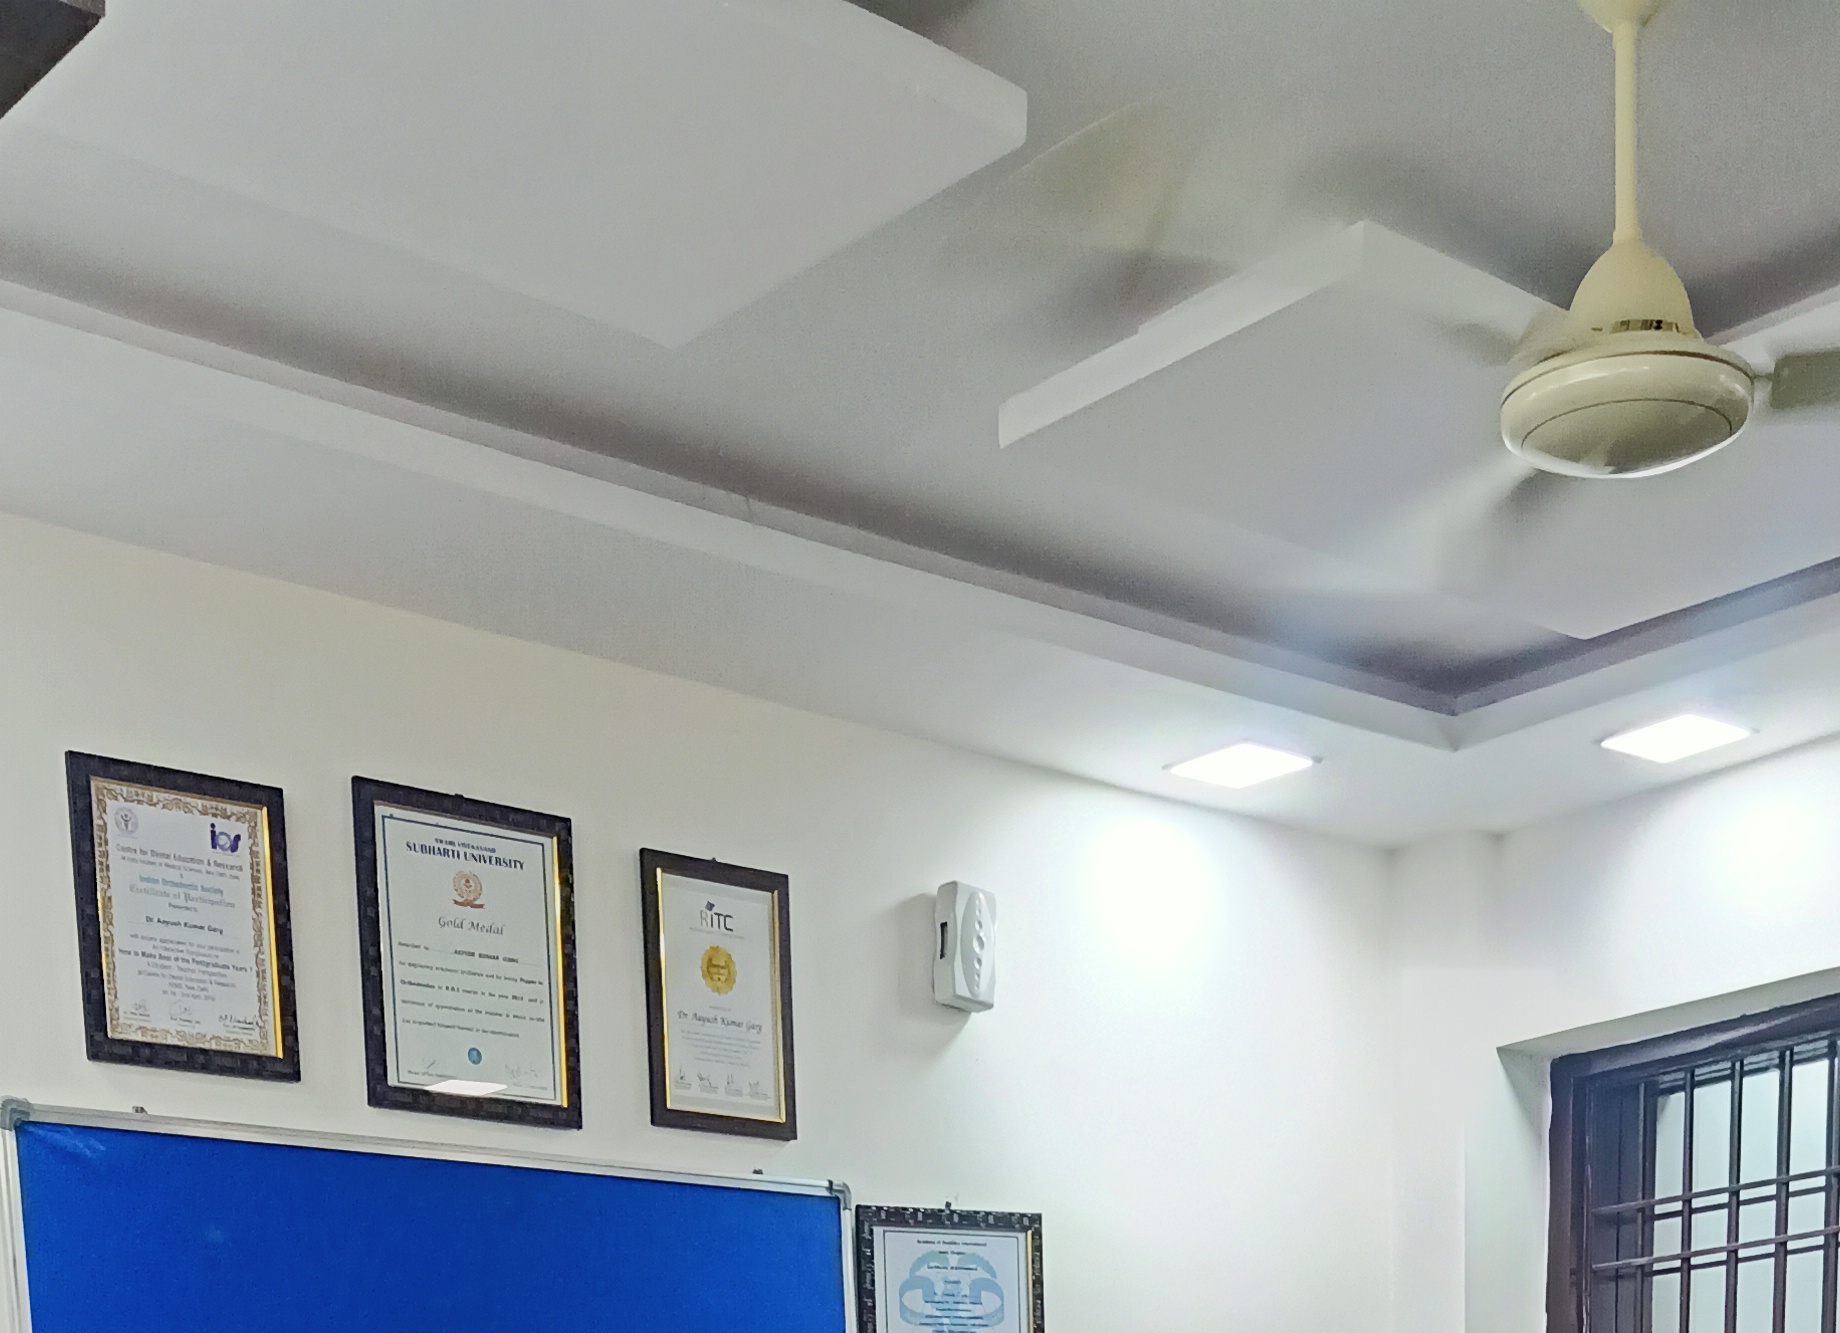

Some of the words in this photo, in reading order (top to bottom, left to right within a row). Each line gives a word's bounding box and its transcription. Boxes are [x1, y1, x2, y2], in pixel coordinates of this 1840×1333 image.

[405, 841, 461, 861] SUBHARTI
[463, 851, 525, 871] UNIVERSITY
[438, 915, 466, 930] Gold
[467, 920, 506, 936] Medal
